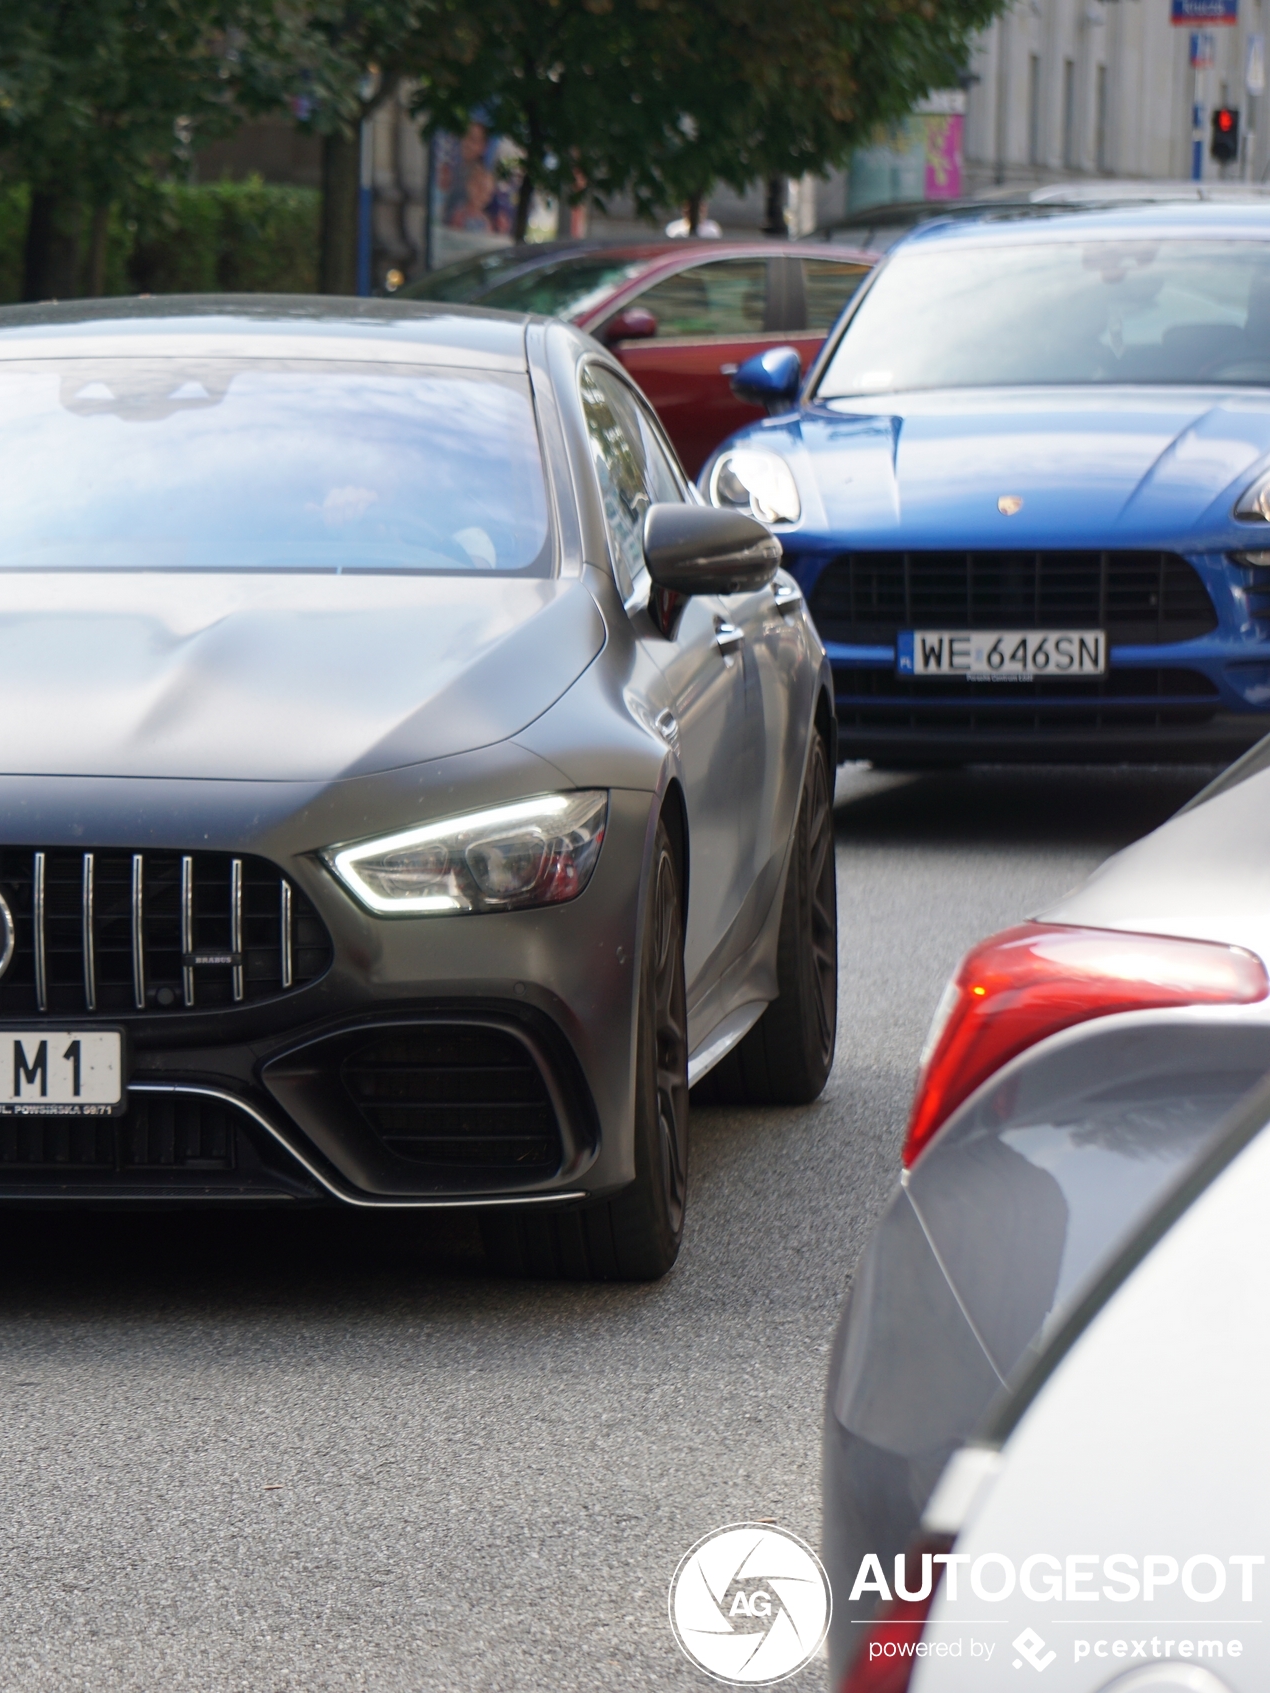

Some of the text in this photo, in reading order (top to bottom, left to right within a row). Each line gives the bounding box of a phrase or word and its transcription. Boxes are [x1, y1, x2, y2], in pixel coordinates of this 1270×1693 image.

[921, 636, 1100, 671] WE 646SN
[195, 956, 232, 964] BRABUS
